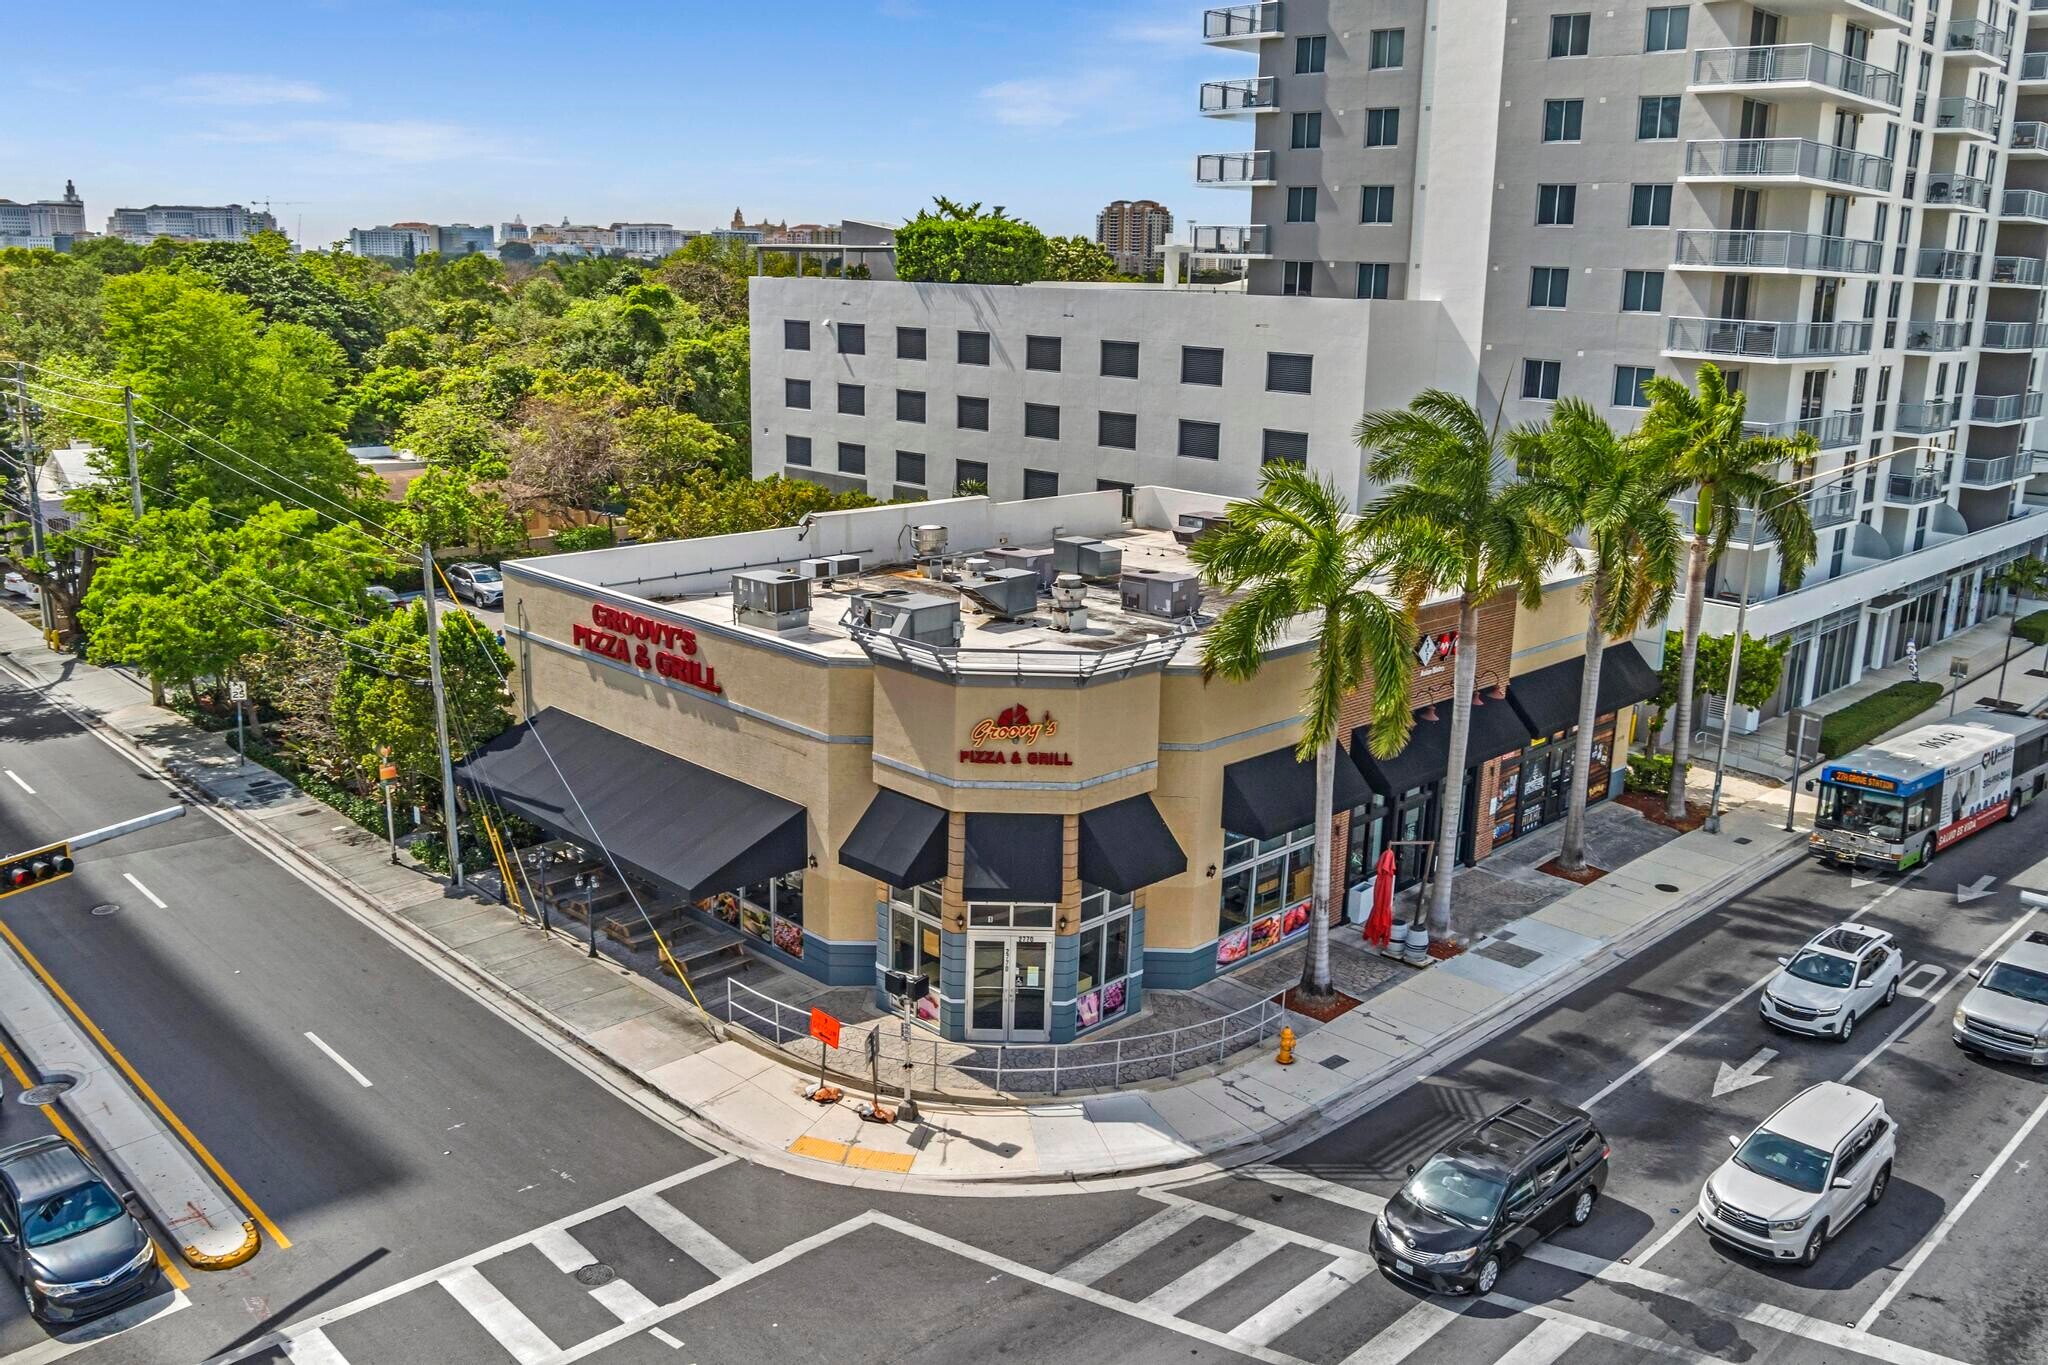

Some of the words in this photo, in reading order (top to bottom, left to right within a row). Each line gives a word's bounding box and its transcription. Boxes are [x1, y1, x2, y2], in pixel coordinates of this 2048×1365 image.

[592, 603, 698, 655] GROOVY'S
[573, 624, 631, 663] PIZZA
[635, 643, 652, 669] &
[655, 651, 722, 694] GRILL
[232, 690, 245, 698] 25
[971, 711, 1058, 747] Groovy's
[960, 750, 1006, 765] PIZZA
[1011, 751, 1022, 765] &
[1027, 752, 1073, 766] GRILL
[1848, 774, 1867, 785] GROVE
[1868, 776, 1895, 791] STATION
[1938, 829, 1957, 845] SALUD
